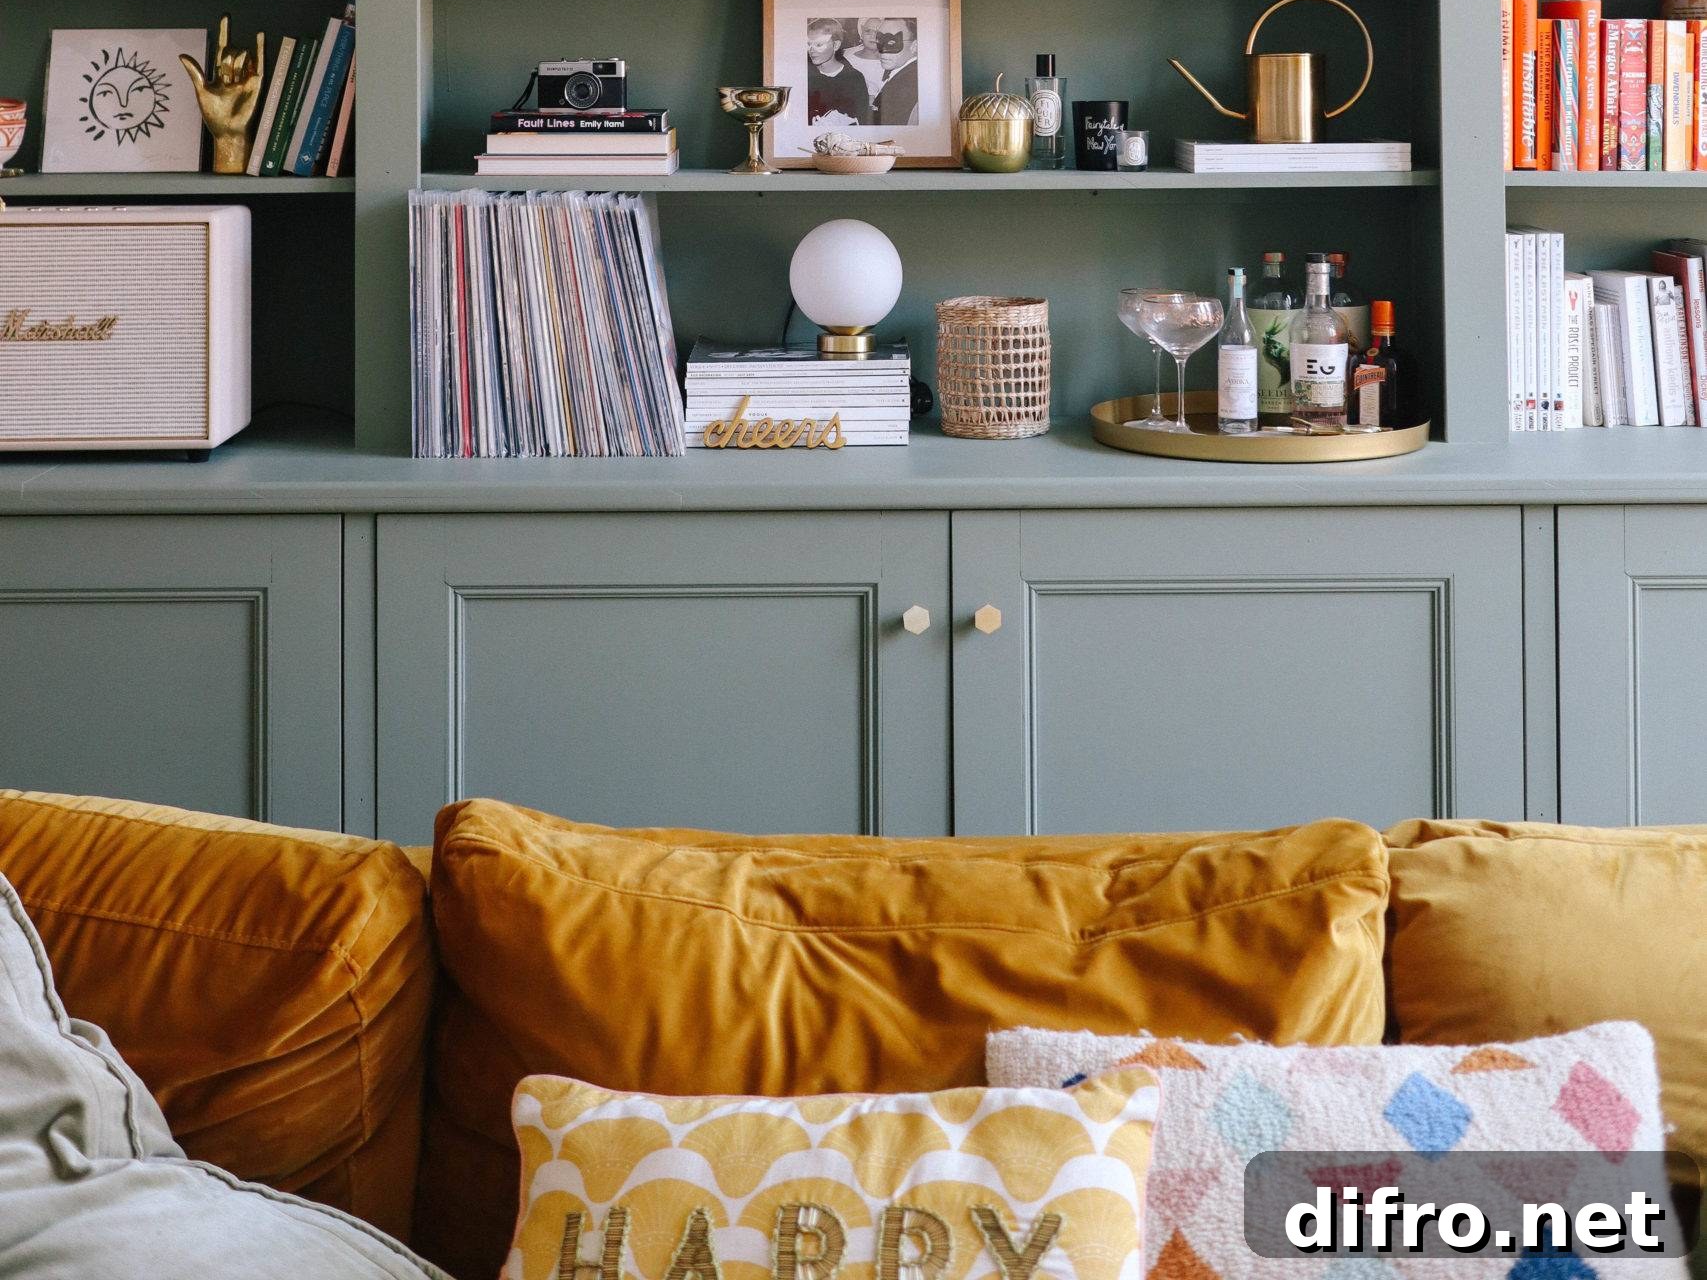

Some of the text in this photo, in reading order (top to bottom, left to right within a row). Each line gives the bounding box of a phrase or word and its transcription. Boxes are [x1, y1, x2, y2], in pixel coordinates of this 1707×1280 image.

[1585, 9, 1596, 110] the PANIC years
[1606, 30, 1619, 115] Margot Affair
[1672, 72, 1680, 91] DAVID
[1521, 51, 1536, 149] insatiable
[518, 118, 625, 130] Fault Lines Emily Itami
[1085, 116, 1119, 137] Fairytale
[1086, 137, 1104, 150] New
[1103, 135, 1118, 155] Yor
[0, 308, 118, 340] Marshall
[1693, 298, 1702, 328] lessons
[1567, 327, 1579, 352] ROSIE
[1663, 328, 1677, 367] anthony
[1678, 324, 1688, 359] ATKINSON
[1307, 359, 1336, 375] EG
[1567, 356, 1579, 388] PROJECT
[1667, 368, 1680, 396] kiedis
[703, 394, 847, 449] cheers
[556, 1201, 1067, 1280] HAPPY
